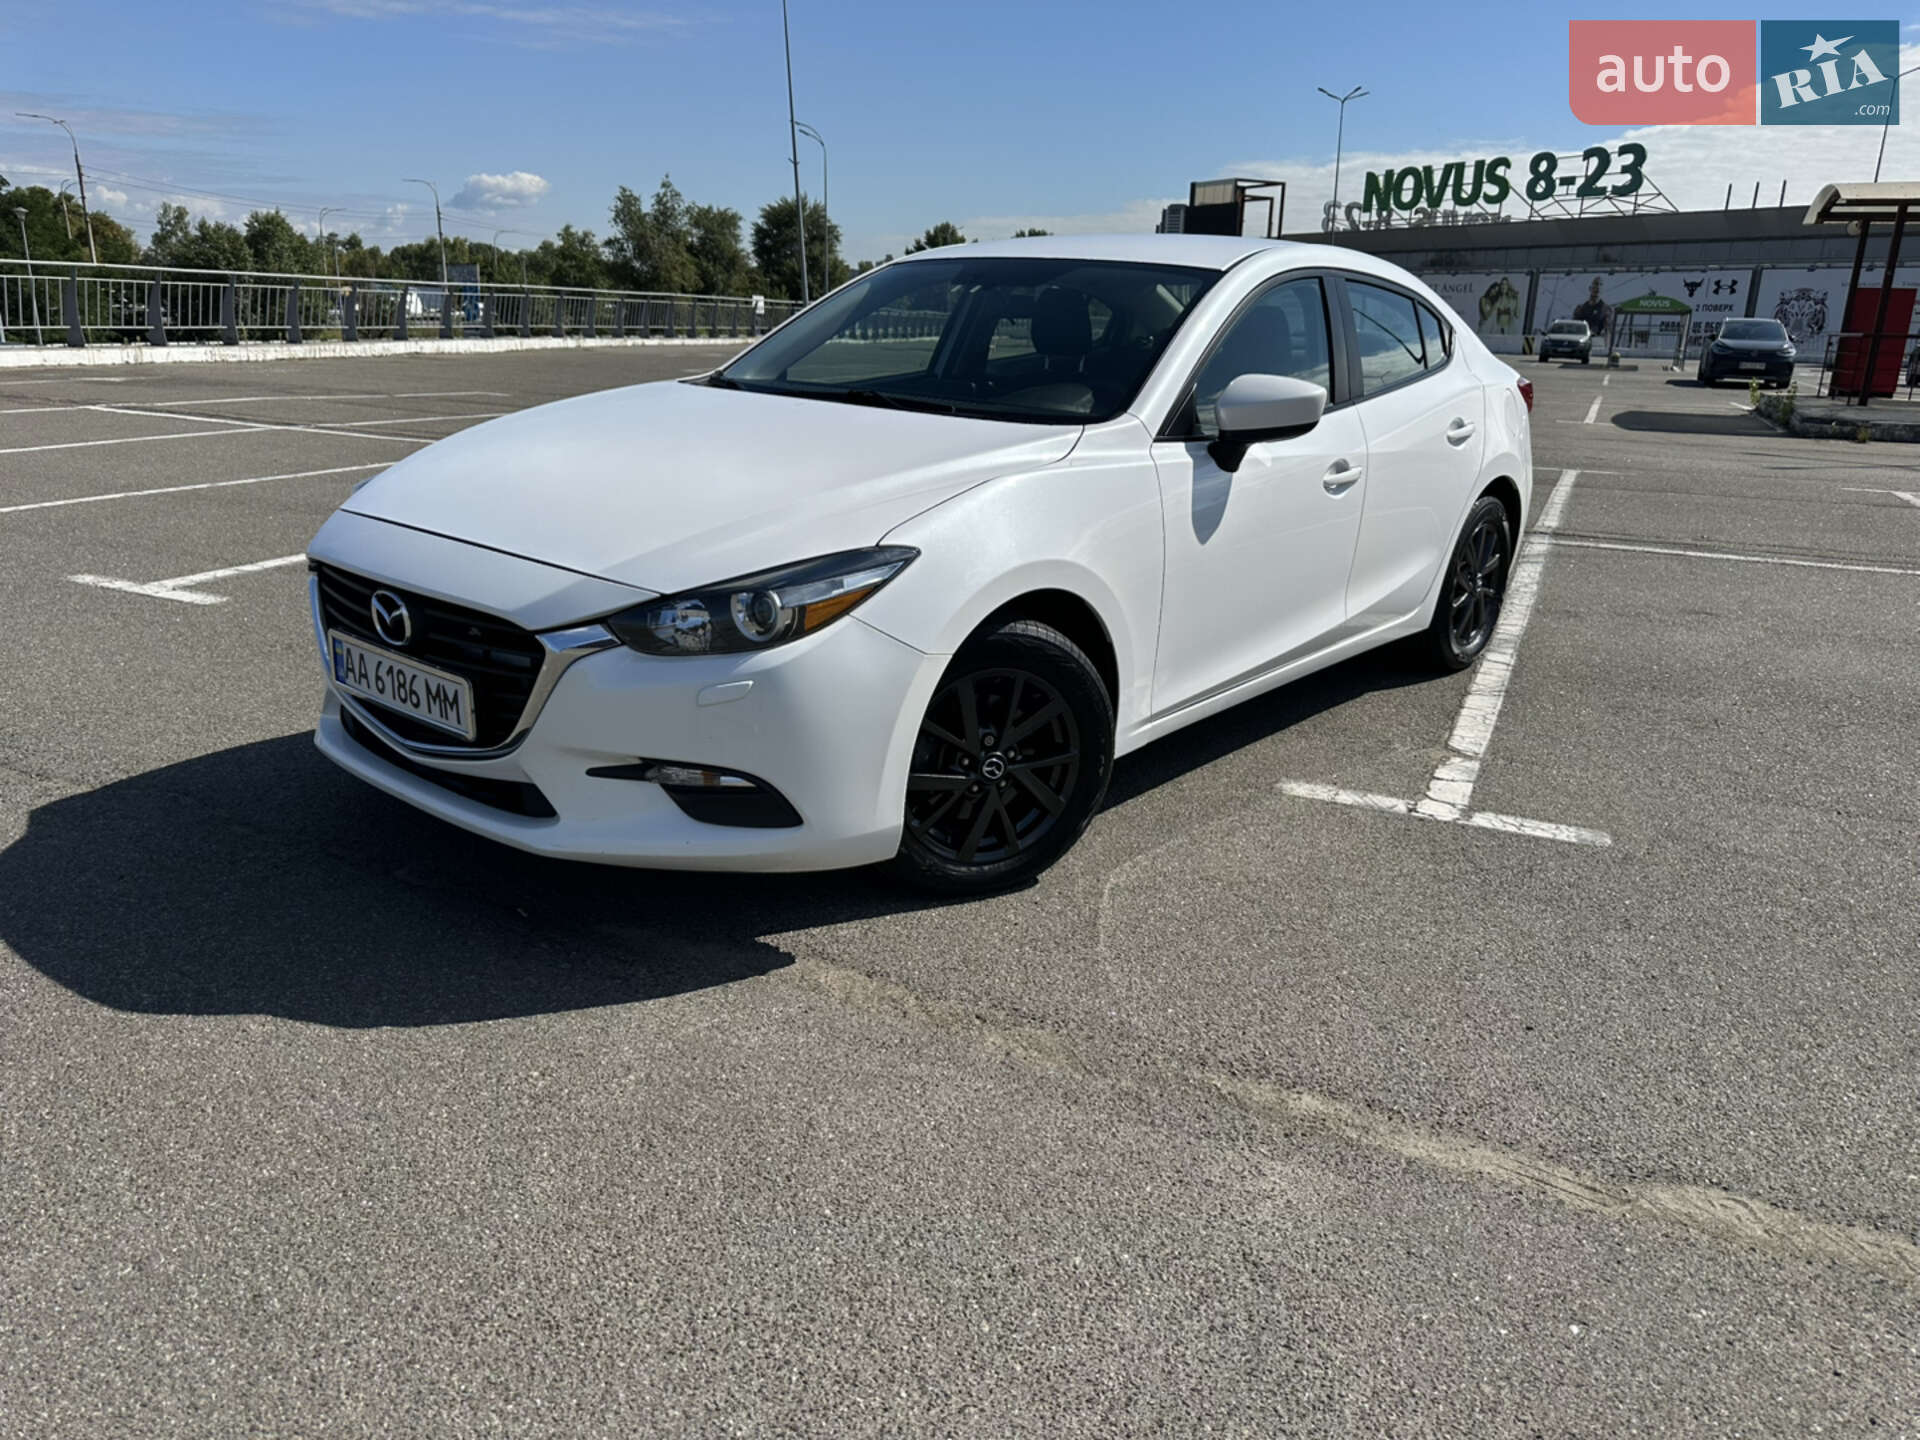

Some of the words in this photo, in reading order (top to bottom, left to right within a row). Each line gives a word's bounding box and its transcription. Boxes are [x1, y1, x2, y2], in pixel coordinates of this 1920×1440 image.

[1362, 157, 1511, 213] NOVUS
[1526, 142, 1647, 202] 8-23
[1440, 282, 1473, 294] ANGEL
[1639, 299, 1671, 308] NOVUS
[344, 647, 370, 689] AA
[375, 660, 421, 709] 6186
[425, 678, 461, 725] MM
